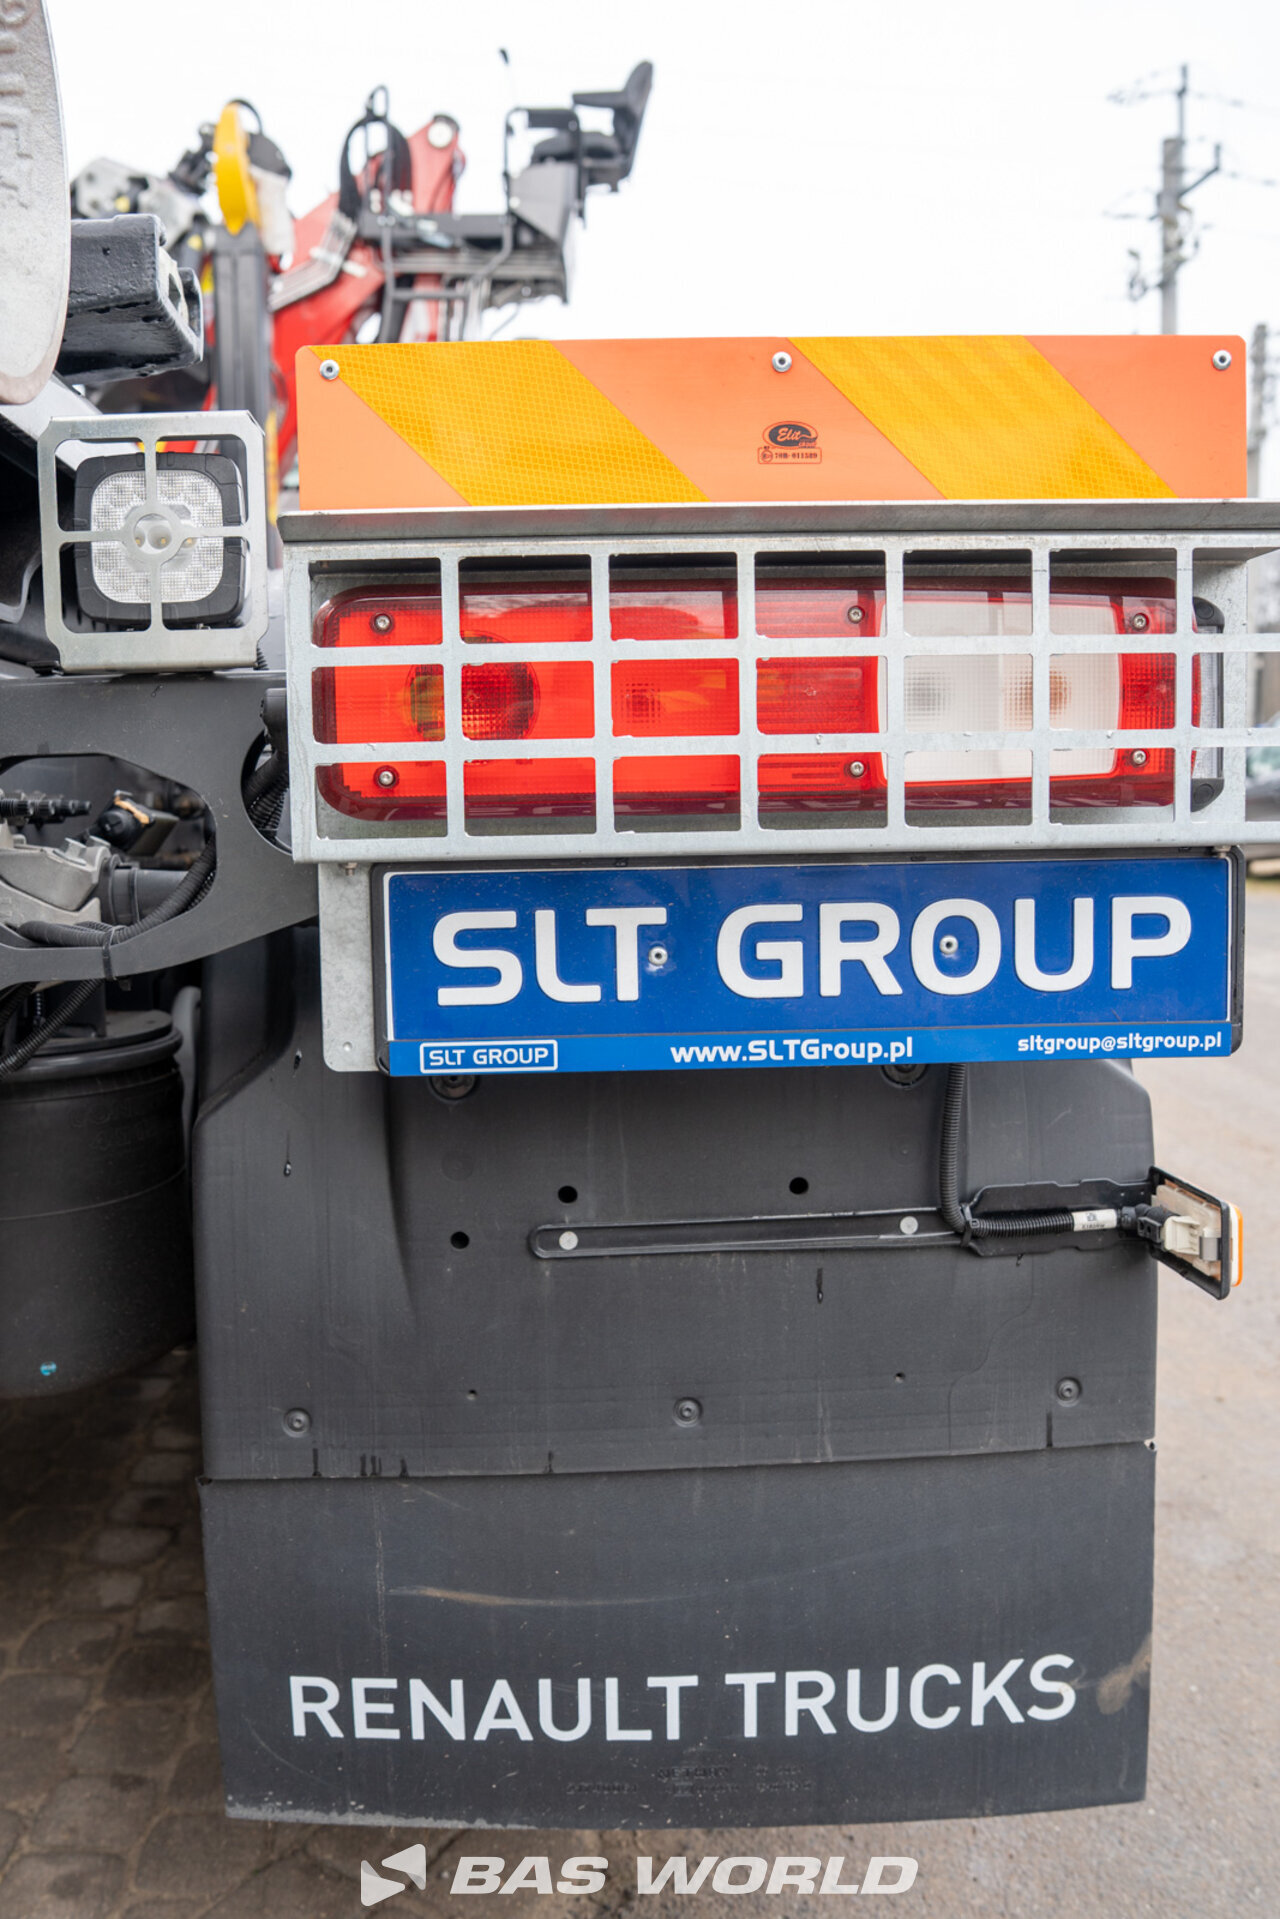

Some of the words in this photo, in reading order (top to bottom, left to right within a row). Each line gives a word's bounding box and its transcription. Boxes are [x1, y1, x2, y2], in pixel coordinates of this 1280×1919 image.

[776, 427, 801, 441] Elit
[433, 907, 668, 1006] SLT
[717, 895, 1193, 1000] GROUP
[670, 1036, 914, 1064] www.SLTGroup.pl
[1017, 1031, 1222, 1055] sltgroup@sltgroup.pl
[429, 1049, 466, 1067] SLT
[472, 1047, 549, 1066] GROUP
[289, 1673, 699, 1742] RENAULT
[724, 1653, 1077, 1739] TRUCKS
